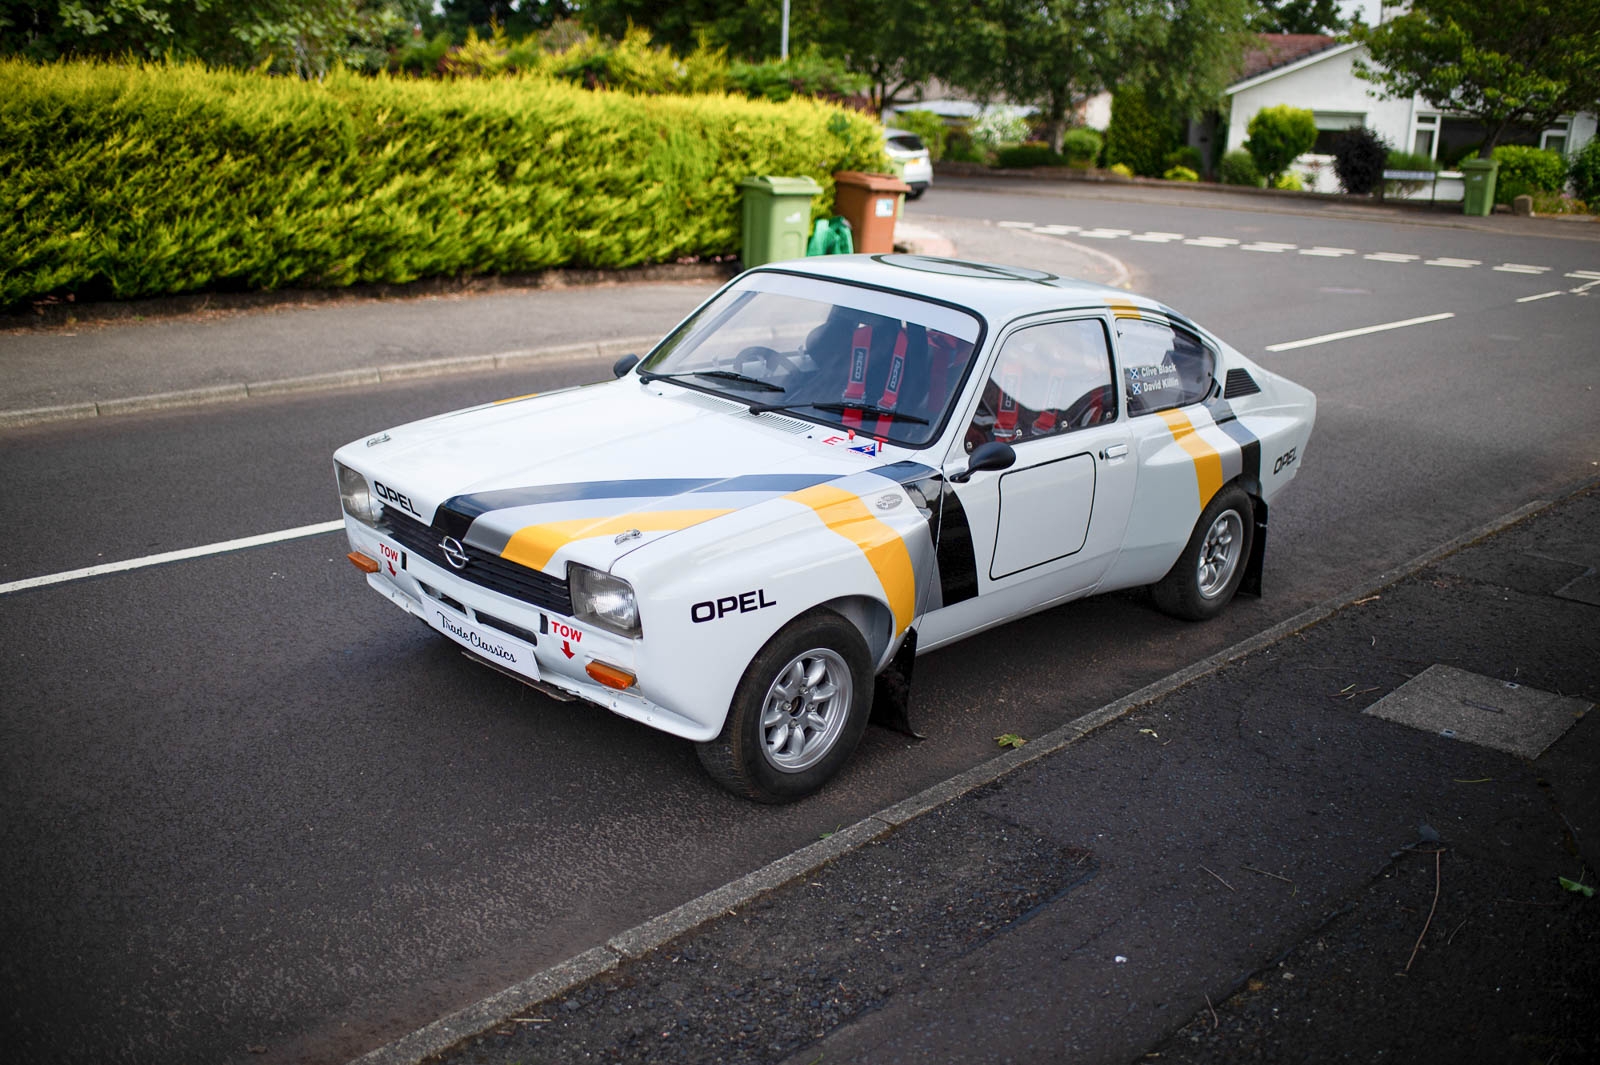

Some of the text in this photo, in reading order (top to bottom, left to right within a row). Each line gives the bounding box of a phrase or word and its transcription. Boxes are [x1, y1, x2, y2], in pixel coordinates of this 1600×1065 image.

[1141, 362, 1177, 377] Clive Black
[1143, 380, 1162, 391] David
[822, 436, 845, 446] E
[1273, 446, 1297, 475] OPEL
[374, 480, 422, 518] OPEL
[379, 543, 398, 562] TOW
[691, 589, 777, 623] OPEL
[551, 621, 583, 642] TOW
